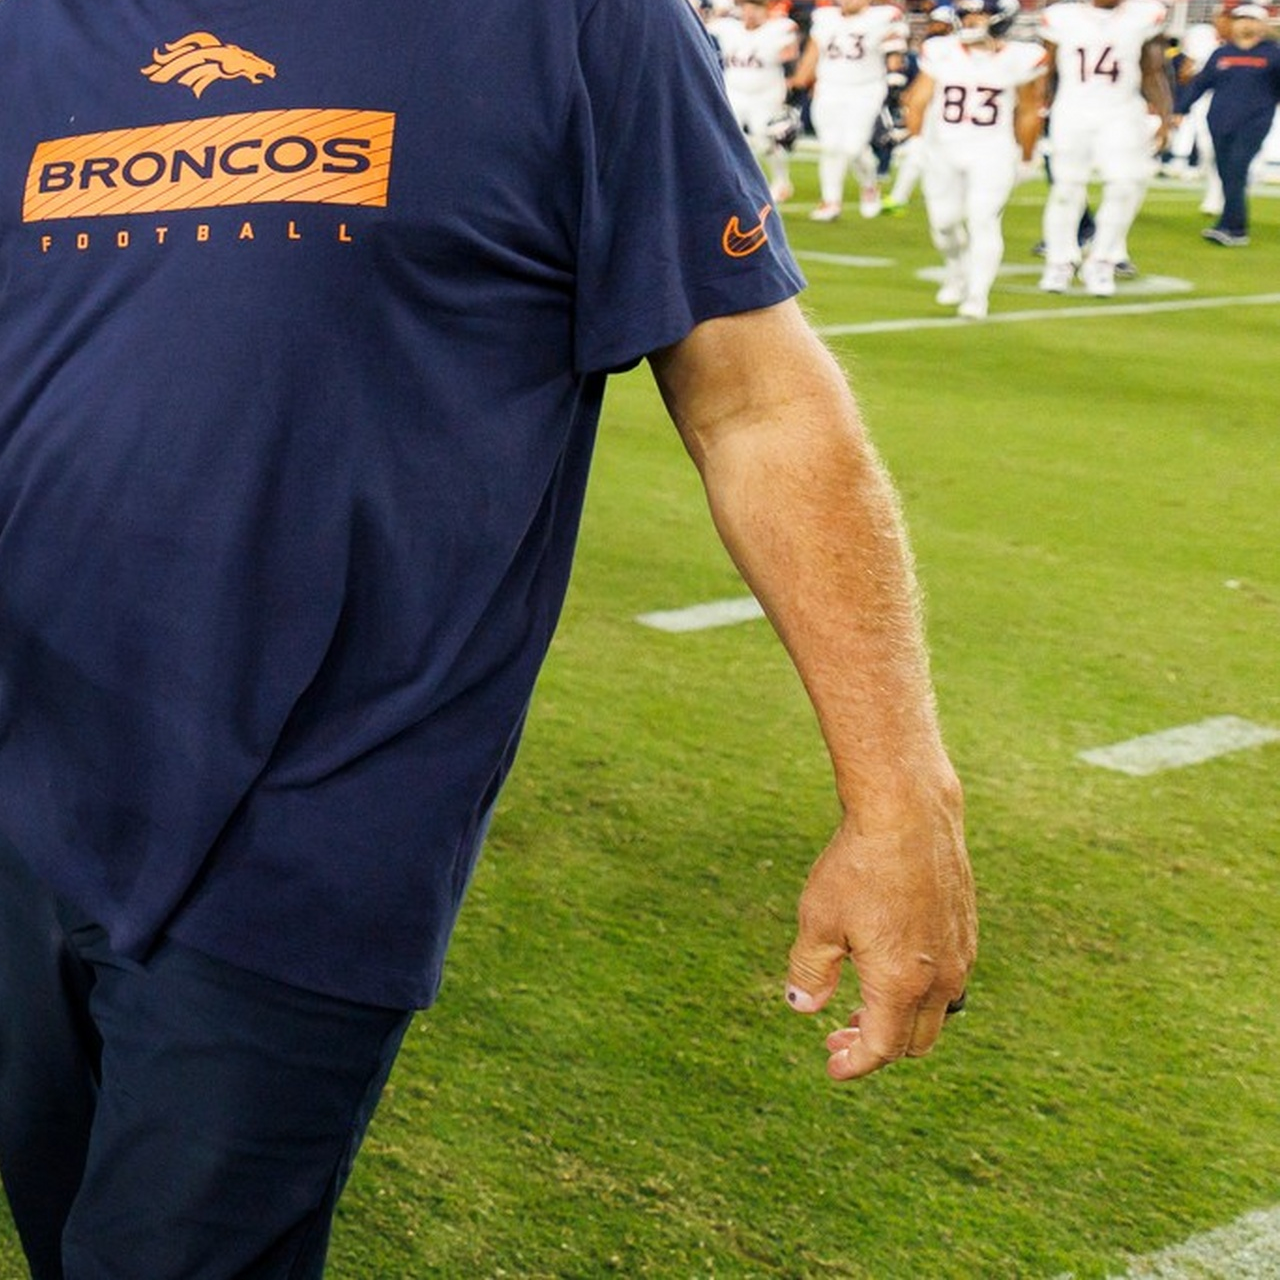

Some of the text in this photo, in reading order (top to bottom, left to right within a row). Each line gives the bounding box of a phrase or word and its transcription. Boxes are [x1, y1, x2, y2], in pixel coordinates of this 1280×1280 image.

[1076, 46, 1120, 84] 14
[942, 85, 1004, 126] 83
[39, 135, 371, 194] BRONCOS
[42, 221, 352, 252] FOOTBALL
